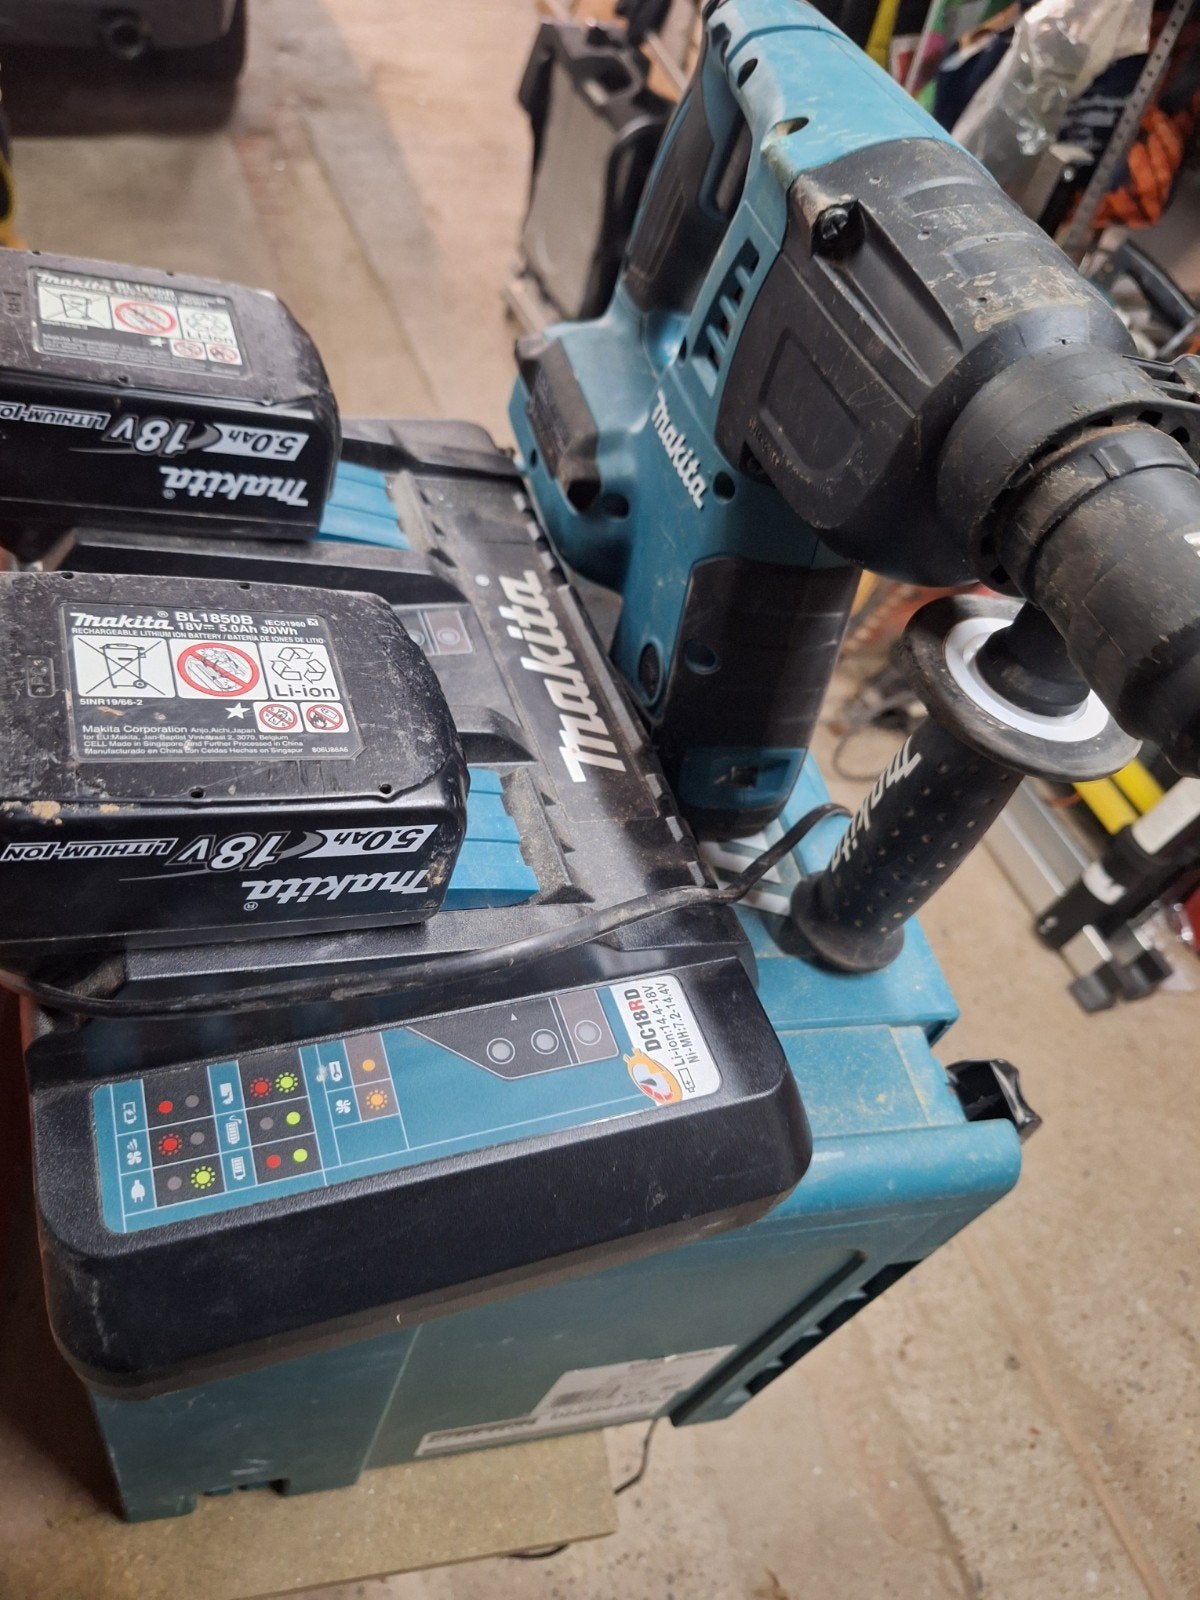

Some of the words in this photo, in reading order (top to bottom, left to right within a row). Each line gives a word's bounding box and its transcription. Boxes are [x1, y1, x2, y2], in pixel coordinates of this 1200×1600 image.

[0, 403, 109, 430] LITHIUM-IO
[228, 429, 300, 453] 5.0Ah
[651, 389, 707, 510] makita
[159, 466, 309, 507] makita
[69, 612, 175, 631] makita
[175, 611, 254, 625] BL1850B
[219, 624, 258, 634] 5.0Ah
[260, 626, 298, 635] 90Wh
[71, 627, 138, 637] RECHARGEABLE
[140, 630, 171, 638] LITHIUM
[173, 631, 187, 639] ION
[188, 632, 222, 640] BATTERY
[272, 635, 293, 643] IONES
[306, 637, 324, 645] LITIO
[498, 569, 627, 783] makita
[274, 684, 336, 698] Li-ion
[82, 724, 120, 733] Makita
[123, 724, 187, 735] Corporation
[143, 741, 183, 749] Singapore
[2, 838, 179, 862] LITHIUM-ION
[333, 828, 424, 851] 5.0Ah
[241, 868, 428, 905] makita
[624, 988, 662, 1052] DC18RD
[642, 985, 686, 1067] Li-ion:14.4-18V
[656, 983, 700, 1064] Ni-MH:7.2-14.4V
